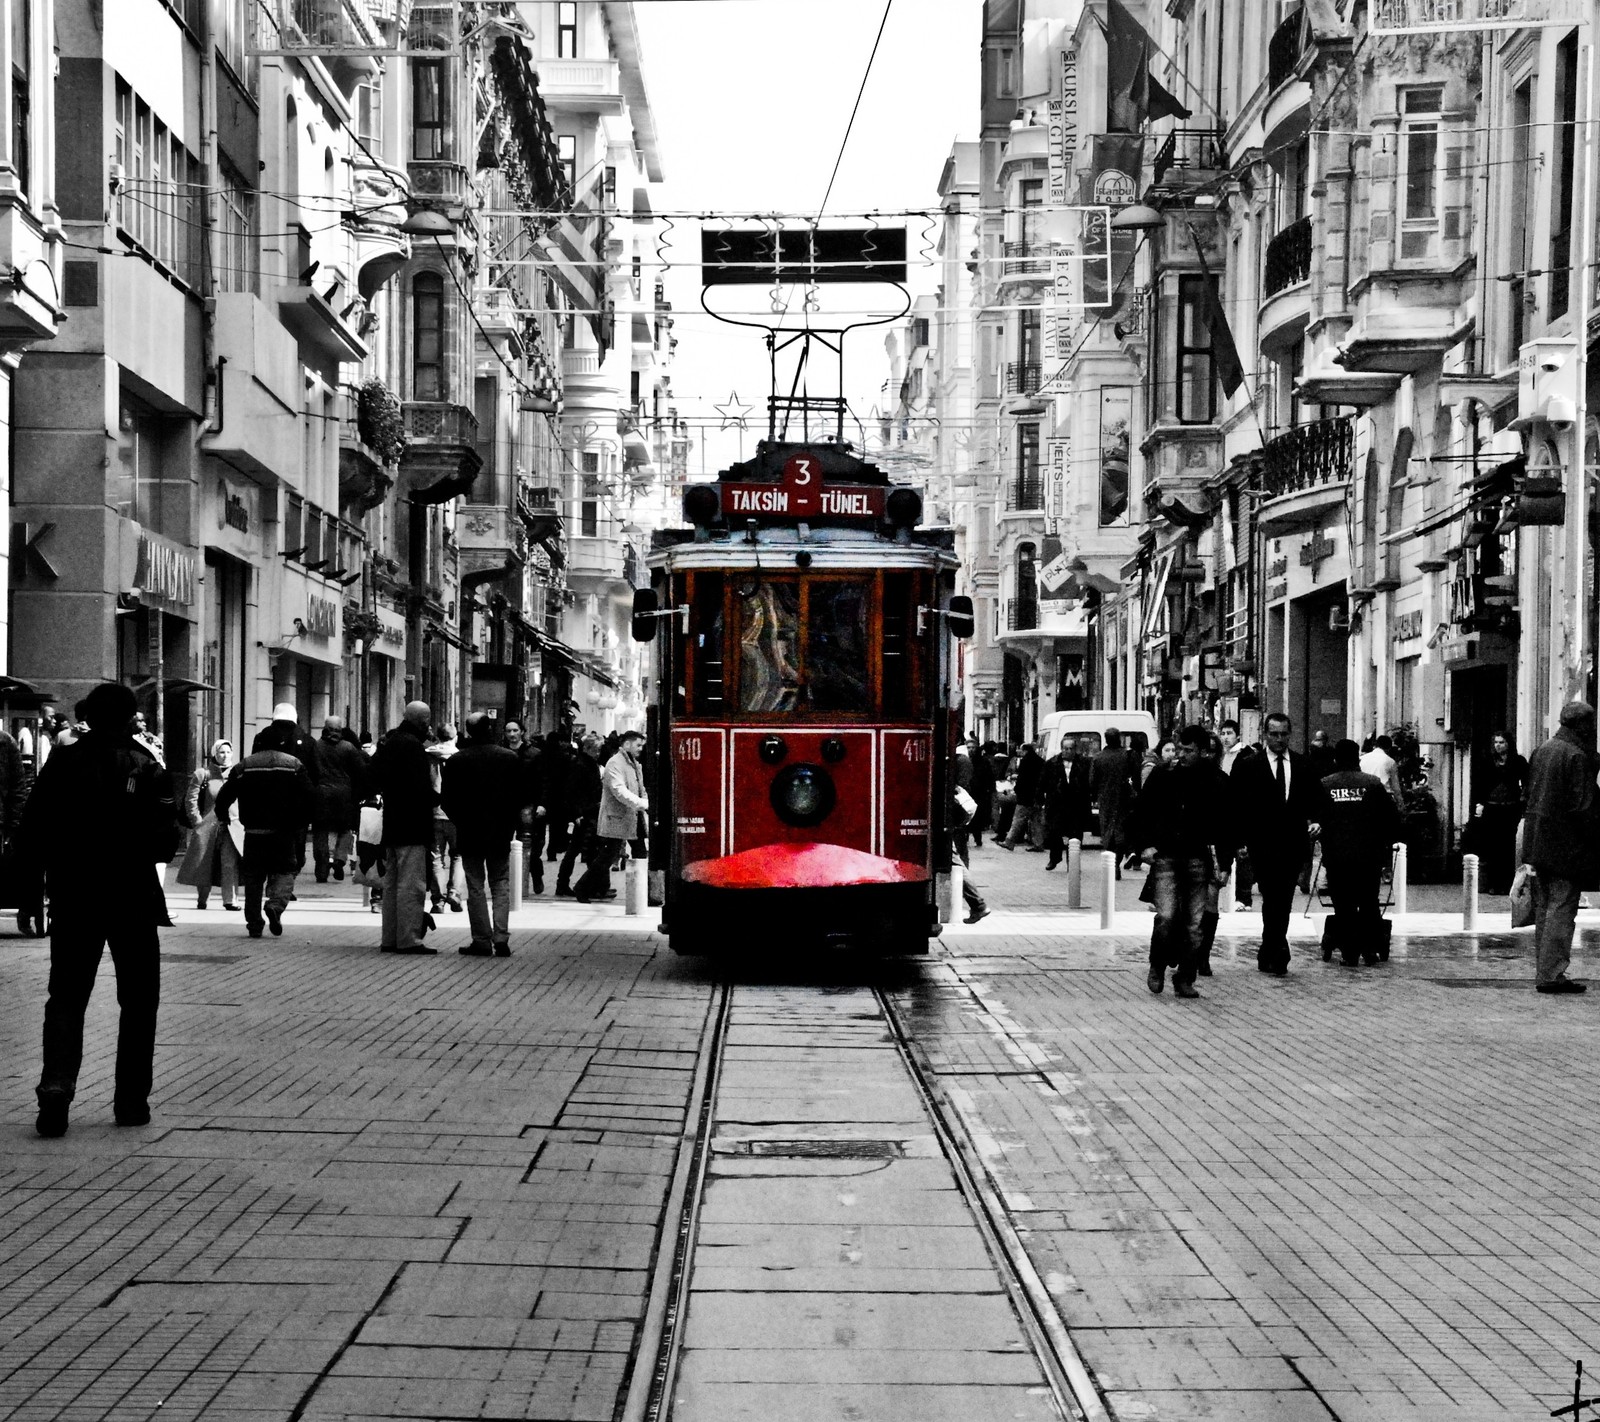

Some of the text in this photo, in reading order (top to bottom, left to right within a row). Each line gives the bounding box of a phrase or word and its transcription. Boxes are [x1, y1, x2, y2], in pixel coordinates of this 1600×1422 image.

[1065, 63, 1077, 150] KURSLARI
[795, 460, 811, 485] 3
[1055, 446, 1063, 481] IELTS
[820, 490, 873, 515] TÜNEL
[12, 522, 59, 577] K
[679, 737, 701, 761] 410
[903, 739, 925, 762] 410
